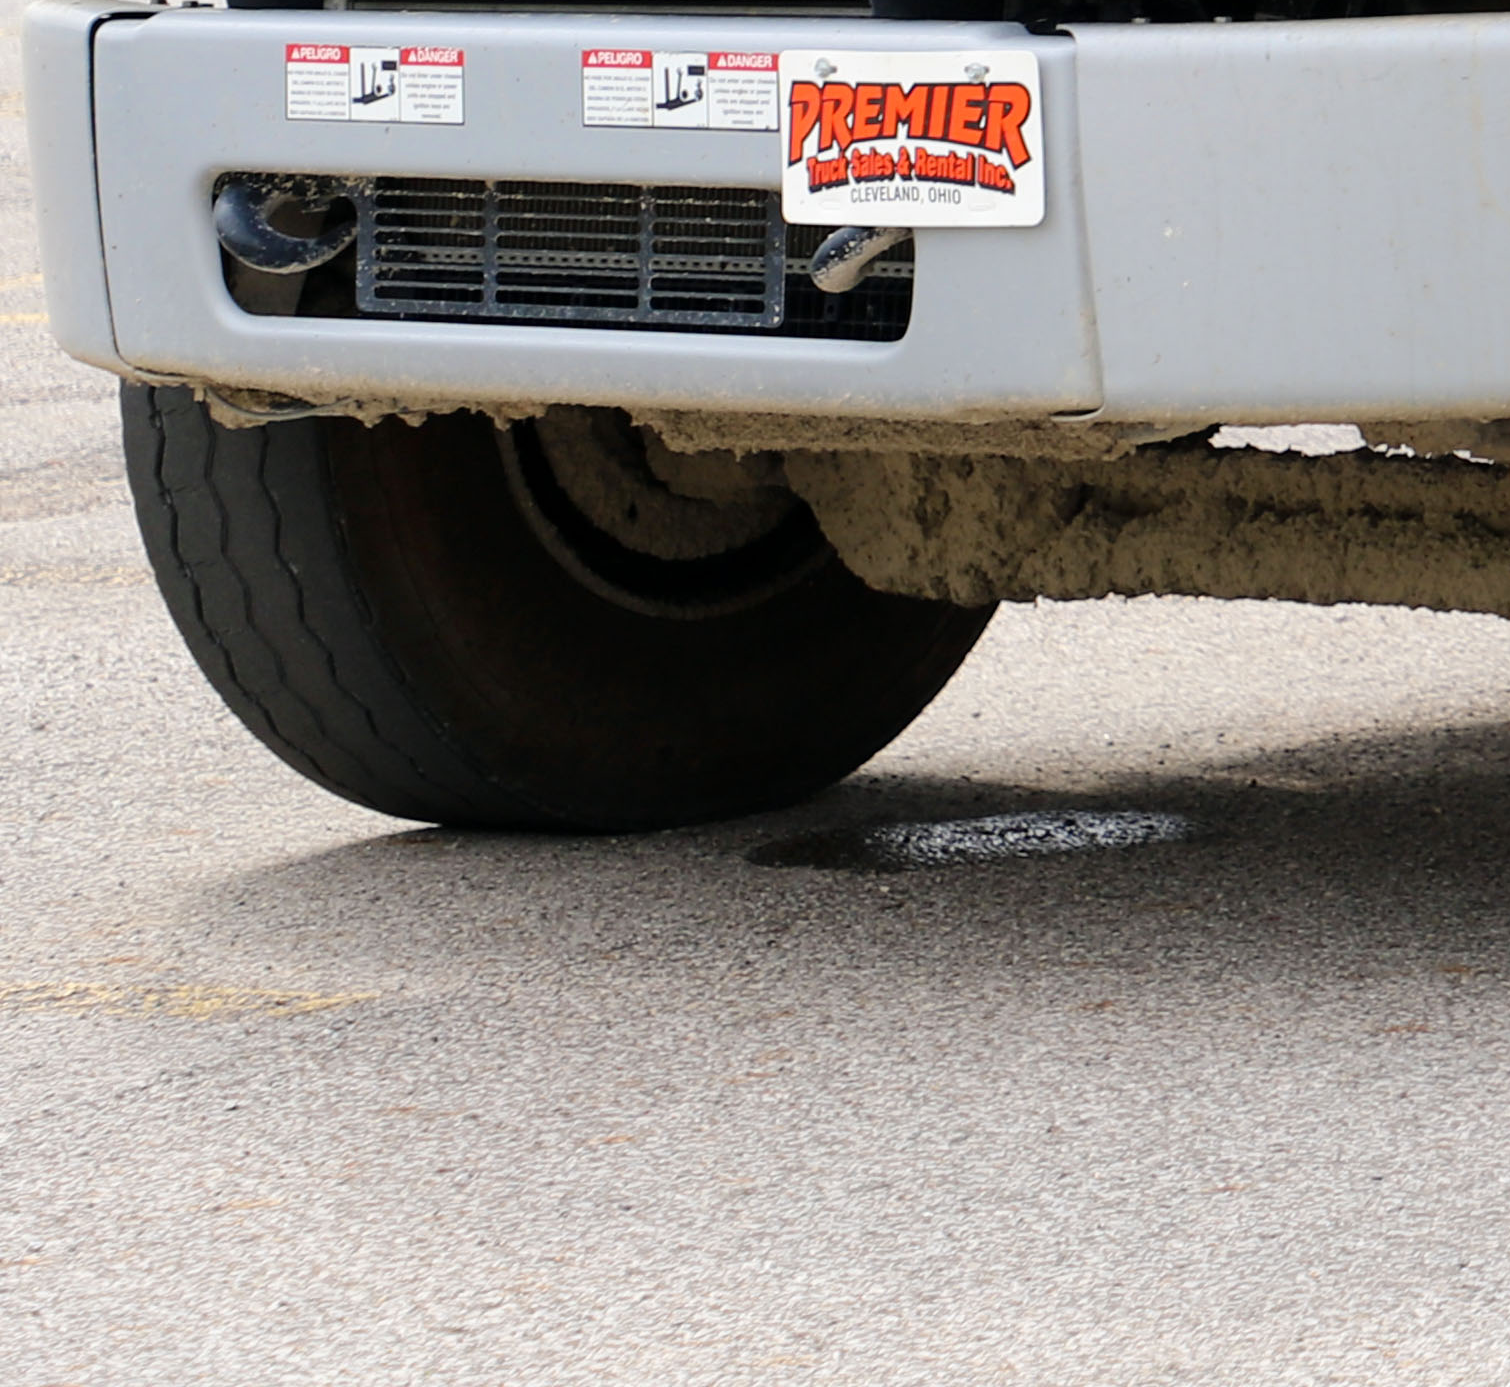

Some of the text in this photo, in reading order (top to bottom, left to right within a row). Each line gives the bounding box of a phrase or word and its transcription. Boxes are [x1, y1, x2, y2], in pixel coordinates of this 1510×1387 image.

[300, 47, 341, 61] PELIGRO
[417, 48, 458, 63] DANGER
[598, 51, 643, 65] PELIGRO
[727, 54, 773, 68] DANGER
[788, 80, 1032, 170] PREMIER
[806, 146, 1015, 196] Truck Sales & Rental Inc.
[850, 186, 962, 205] CLEVELAND, OHIO
